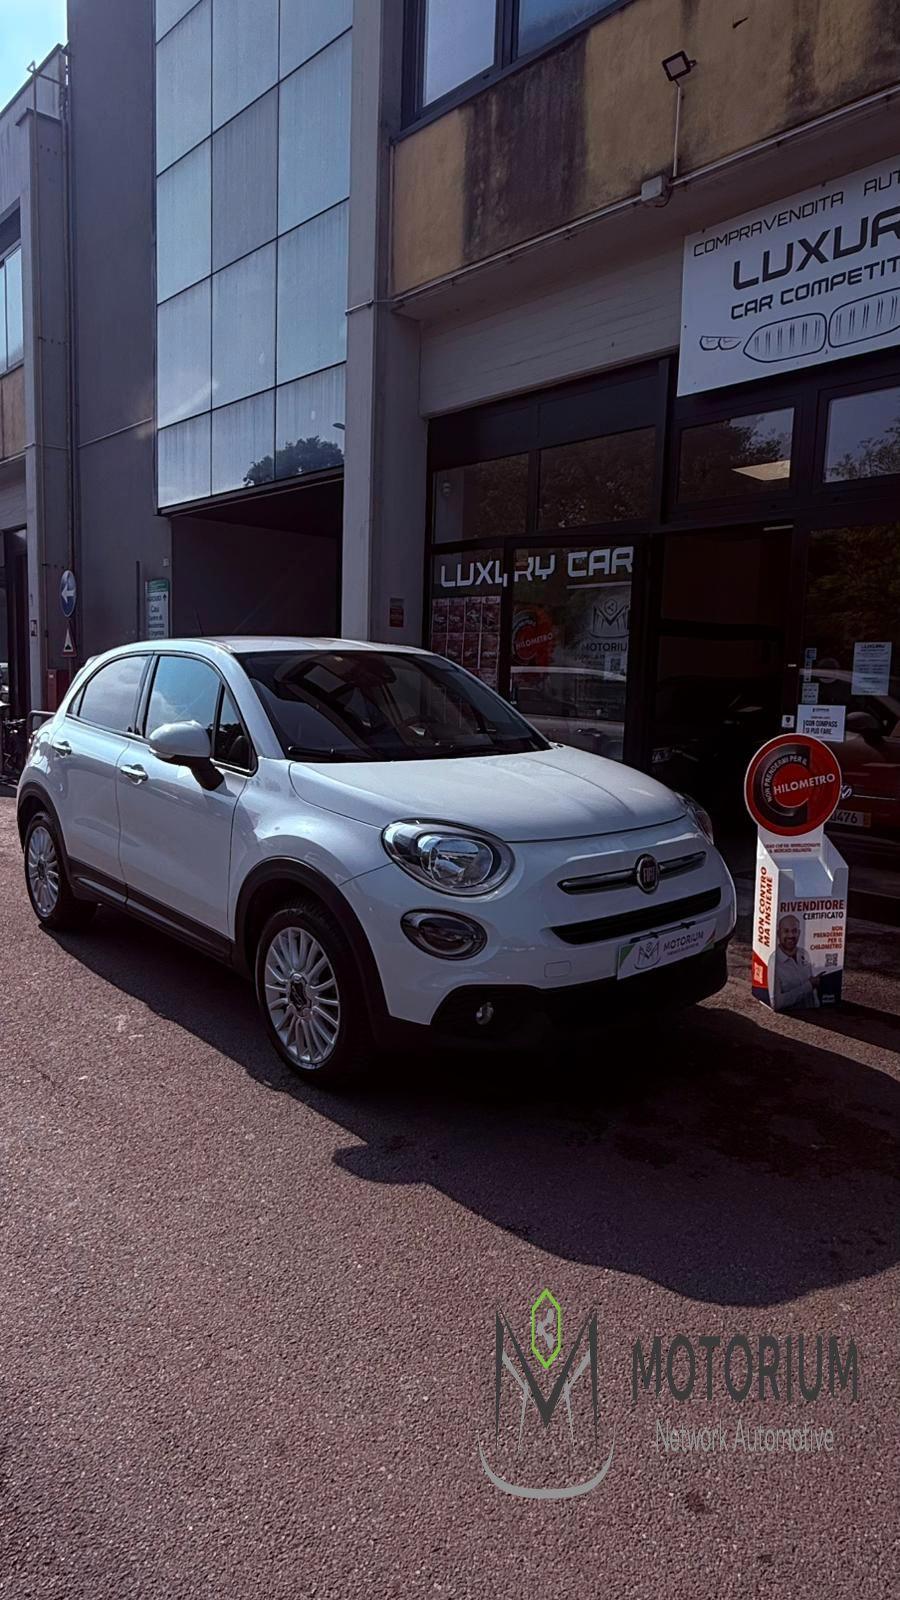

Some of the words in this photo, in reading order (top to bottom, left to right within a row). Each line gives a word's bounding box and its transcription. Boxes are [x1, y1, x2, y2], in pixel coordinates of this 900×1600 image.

[693, 191, 844, 257] COMPRAVENDITA
[731, 294, 773, 320] CAR
[759, 866, 767, 912] CONTRO
[764, 876, 773, 926] INSIEME
[780, 899, 845, 913] RIVENDITORE
[803, 911, 844, 920] CERTIFICATO
[662, 930, 704, 951] MOTORIUM
[757, 918, 765, 943] NON
[763, 930, 771, 947] MA
